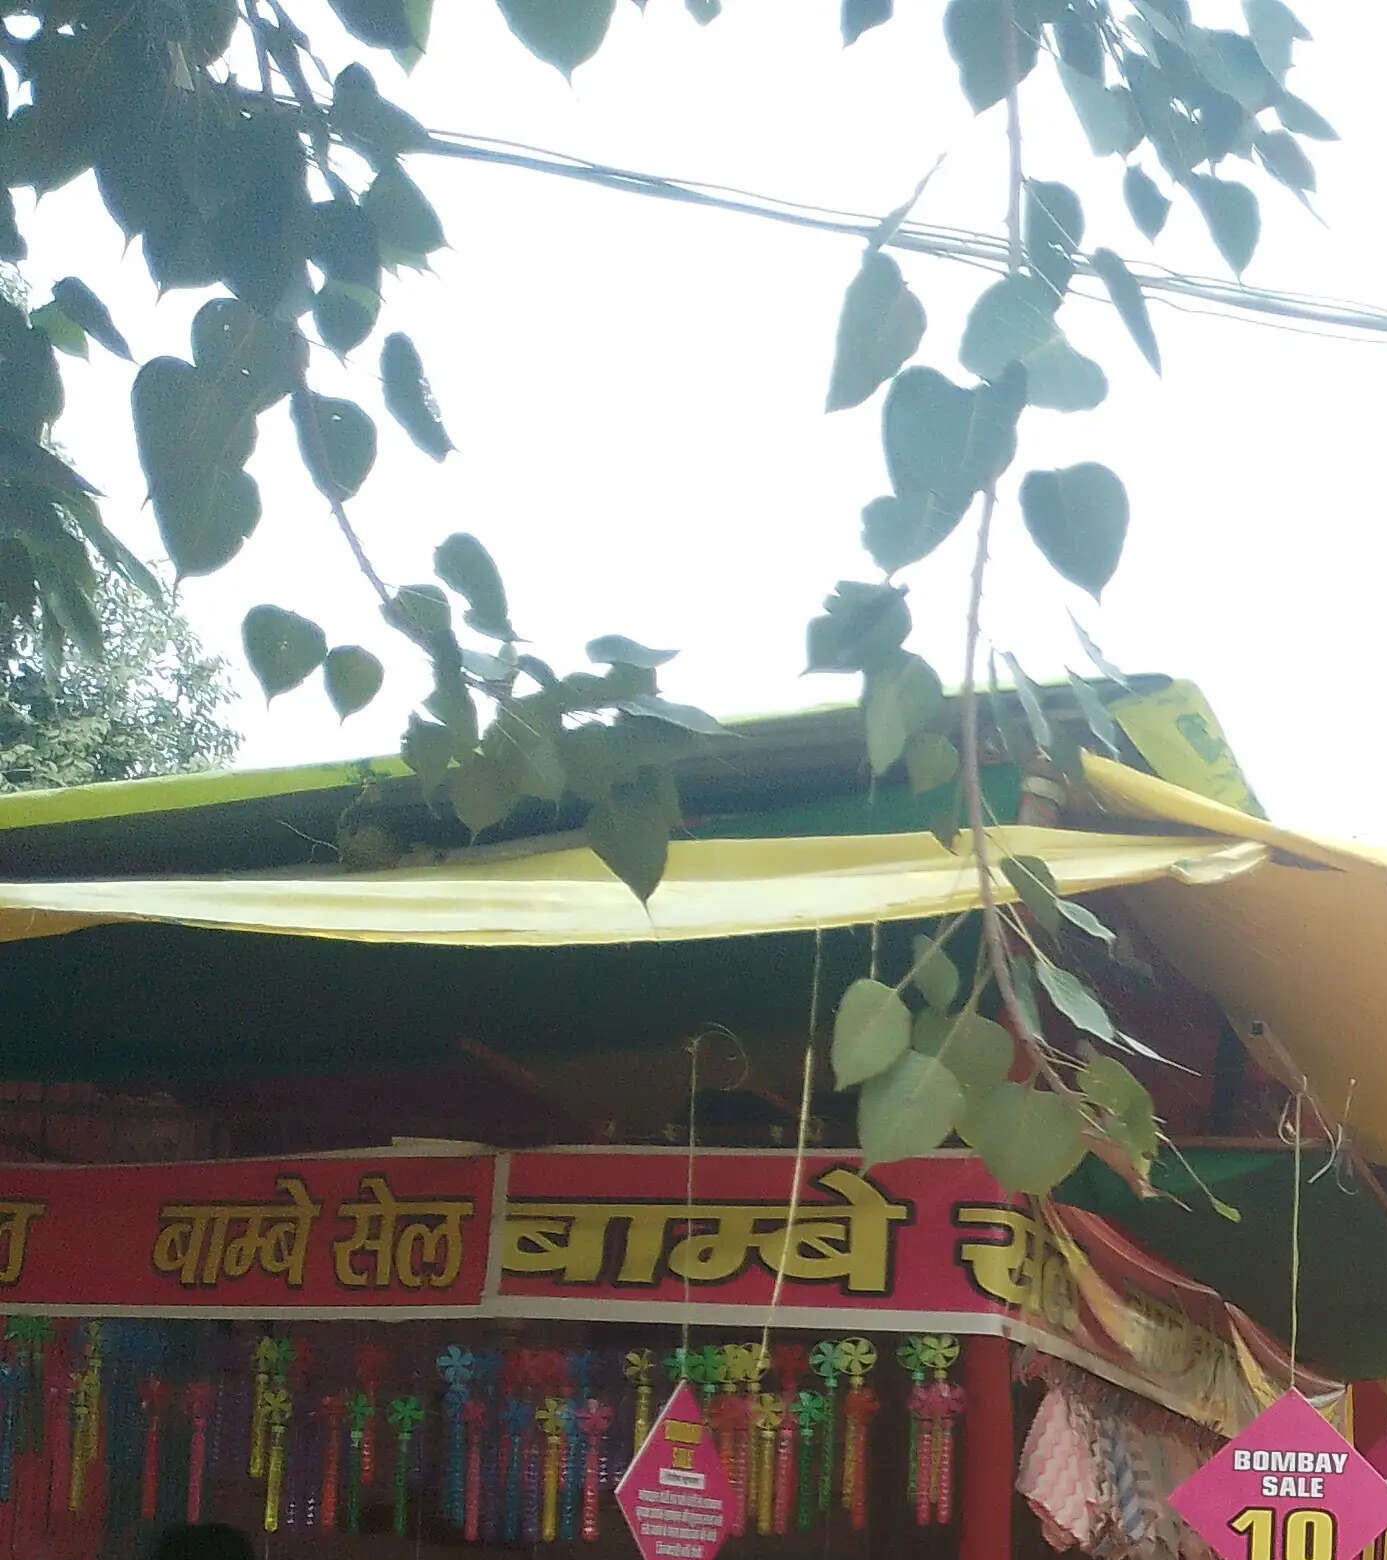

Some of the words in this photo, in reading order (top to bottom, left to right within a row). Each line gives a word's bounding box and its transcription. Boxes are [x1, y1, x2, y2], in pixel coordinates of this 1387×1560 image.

[333, 1173, 474, 1288] सेल
[1233, 1449, 1349, 1474] BOMBAY
[1261, 1475, 1325, 1498] SALE
